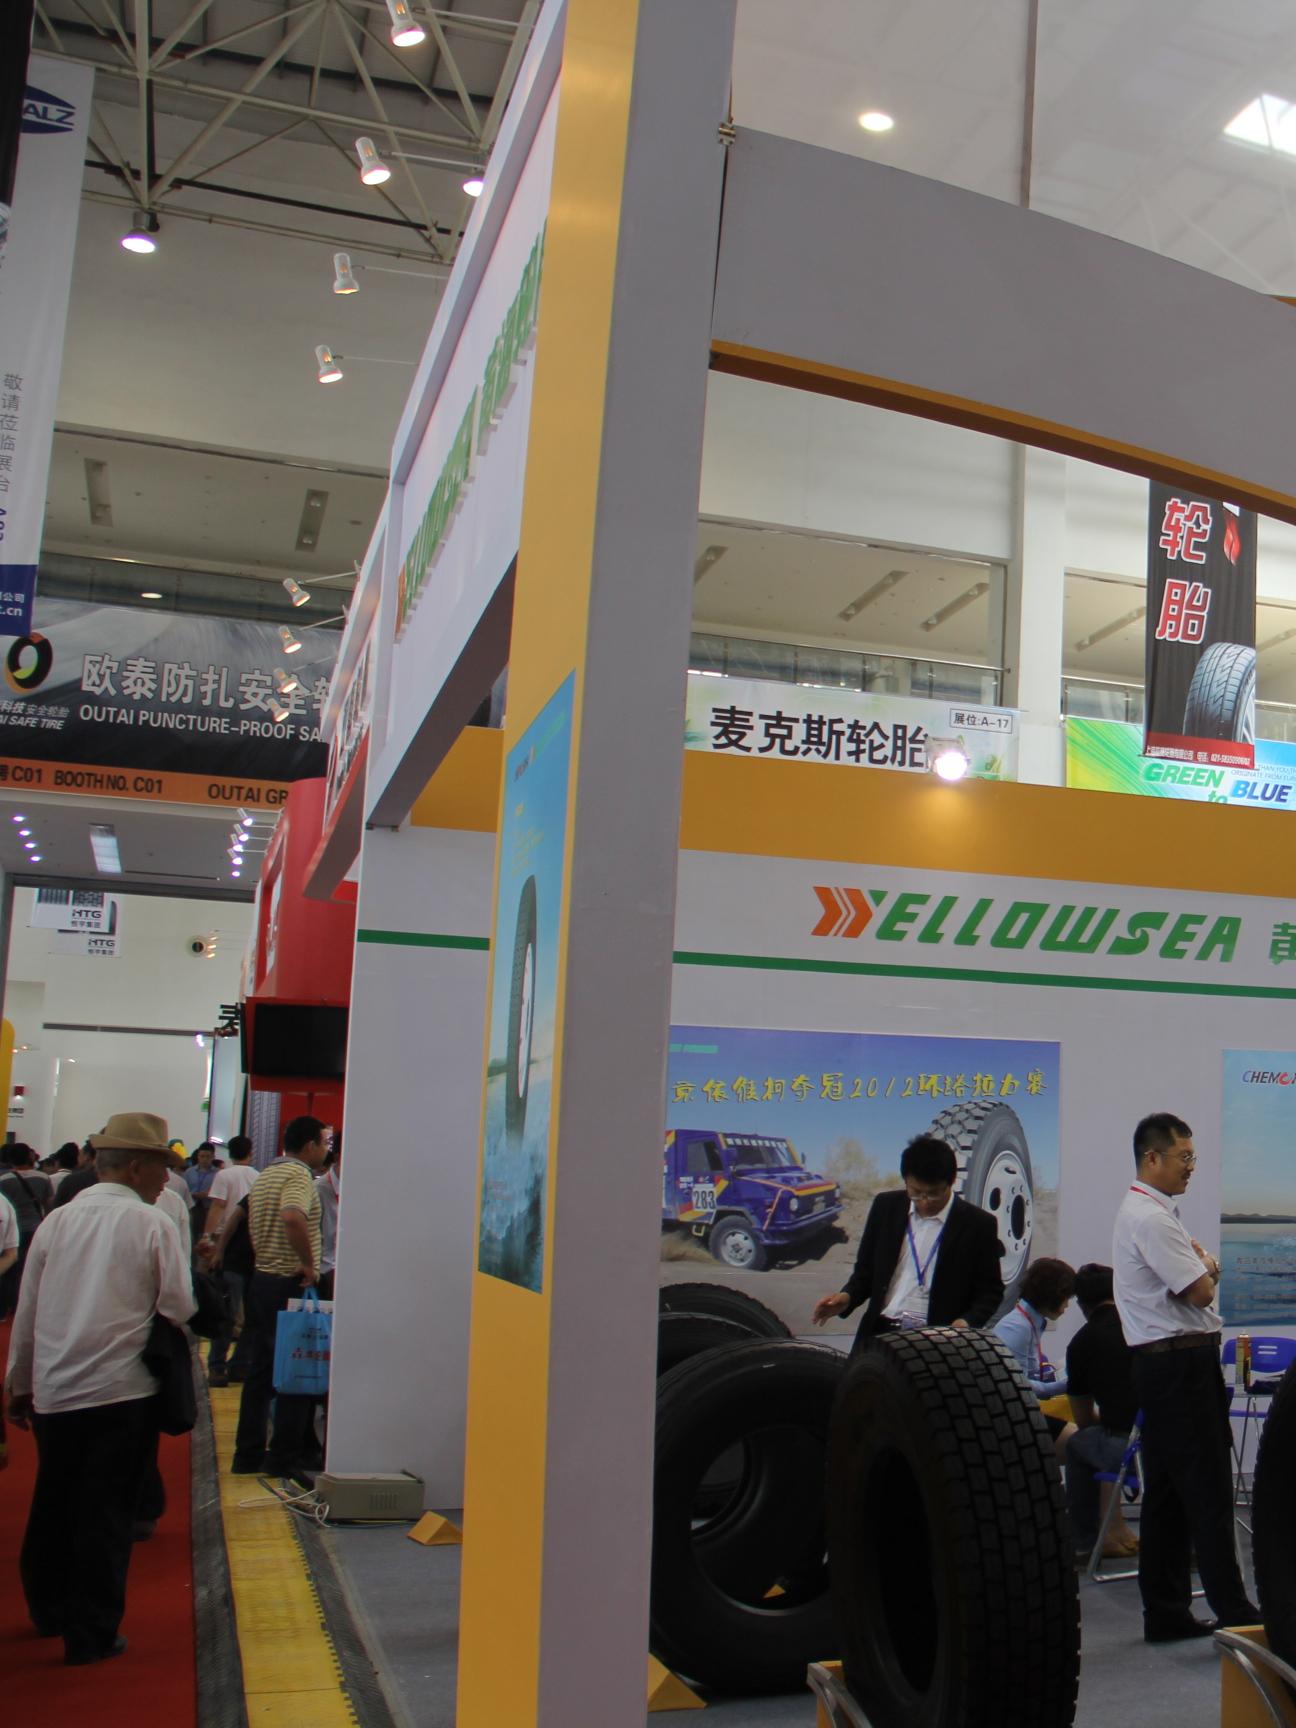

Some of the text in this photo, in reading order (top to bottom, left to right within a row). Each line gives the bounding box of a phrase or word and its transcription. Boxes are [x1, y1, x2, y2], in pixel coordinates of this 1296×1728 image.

[1155, 497, 1213, 645] 轮胎
[9, 715, 39, 728] SAFE
[40, 718, 65, 730] TIRE
[80, 704, 134, 725] OUTAI
[710, 705, 929, 769] 麦克斯轮胎
[12, 765, 43, 784] C01
[54, 770, 102, 789] BOOTH
[133, 775, 163, 794] C01
[1144, 763, 1225, 788] GREEN
[208, 783, 261, 802] OUTAI
[1230, 780, 1293, 803] BLUE
[868, 889, 1243, 964] YELLOWSEA
[693, 1189, 716, 1211] 283
